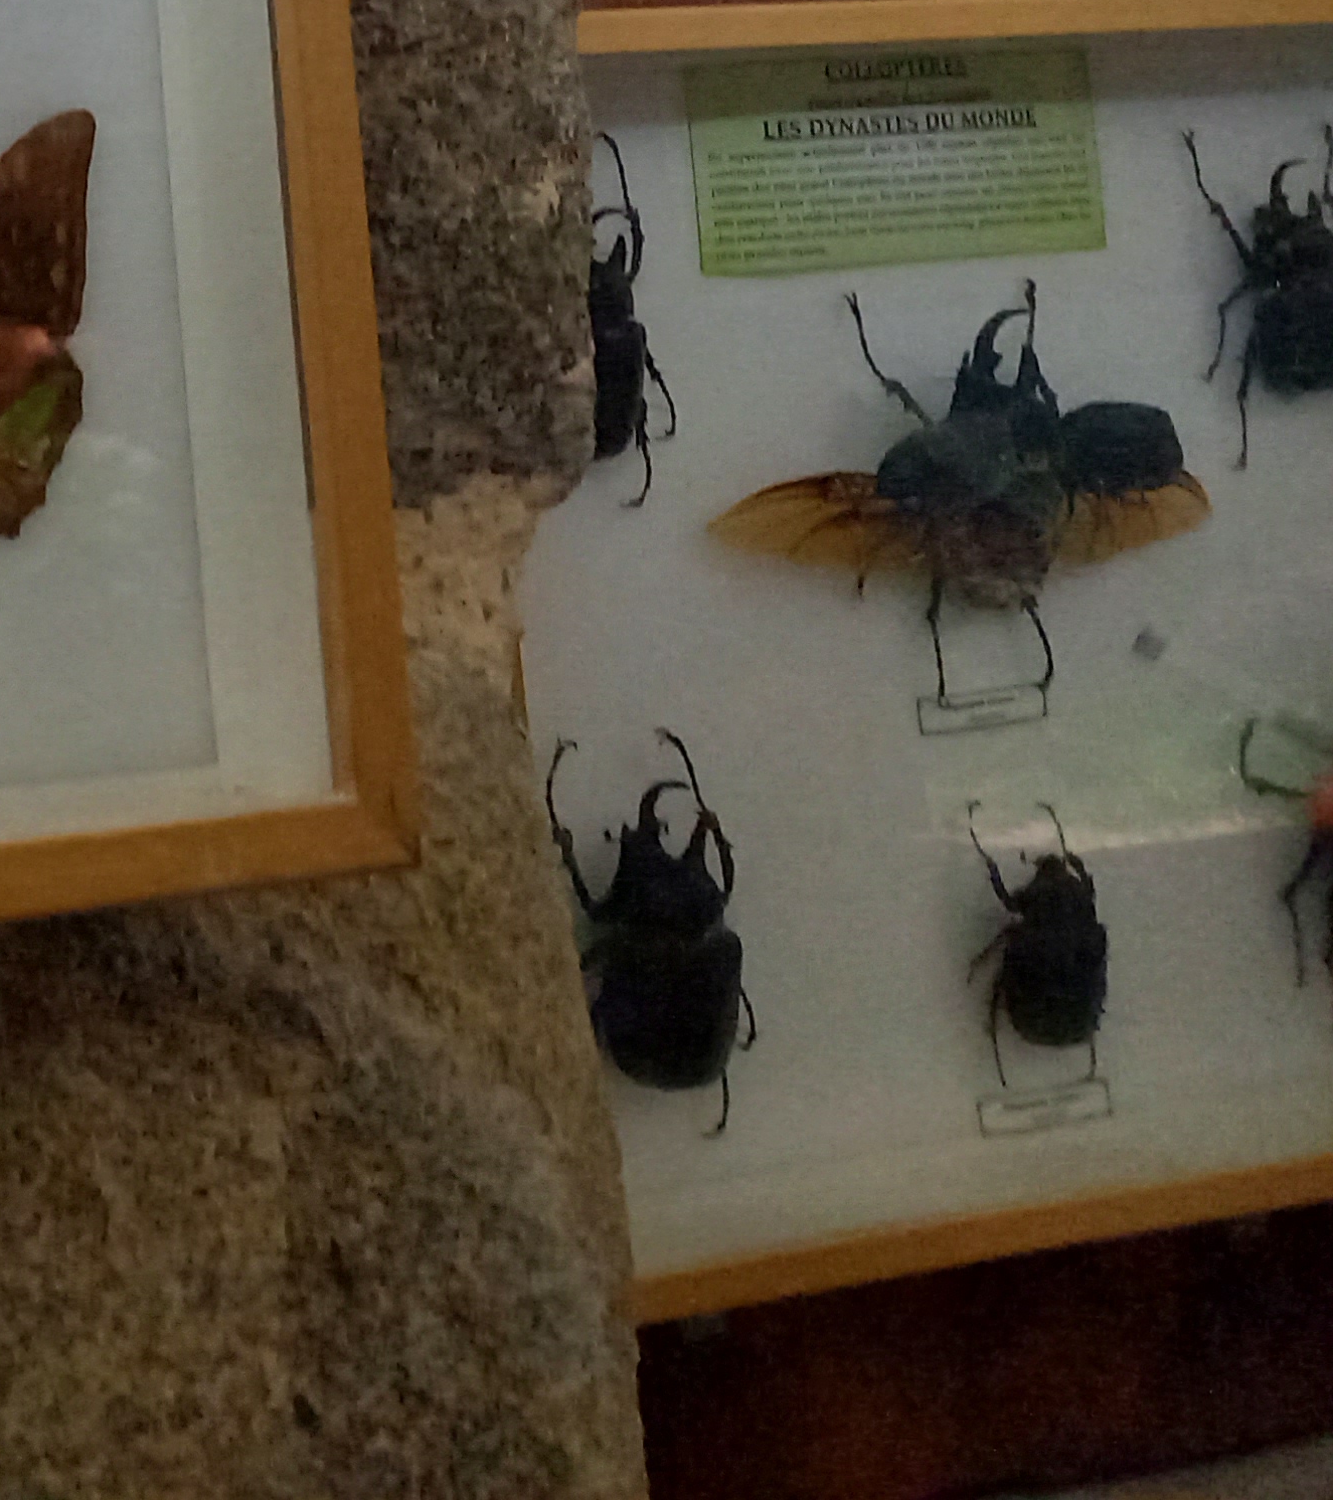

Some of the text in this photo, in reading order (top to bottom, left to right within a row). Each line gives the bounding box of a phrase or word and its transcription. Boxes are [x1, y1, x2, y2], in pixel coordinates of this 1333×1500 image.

[762, 119, 802, 141] LES
[925, 110, 956, 132] DU
[961, 105, 1038, 131] MONDE
